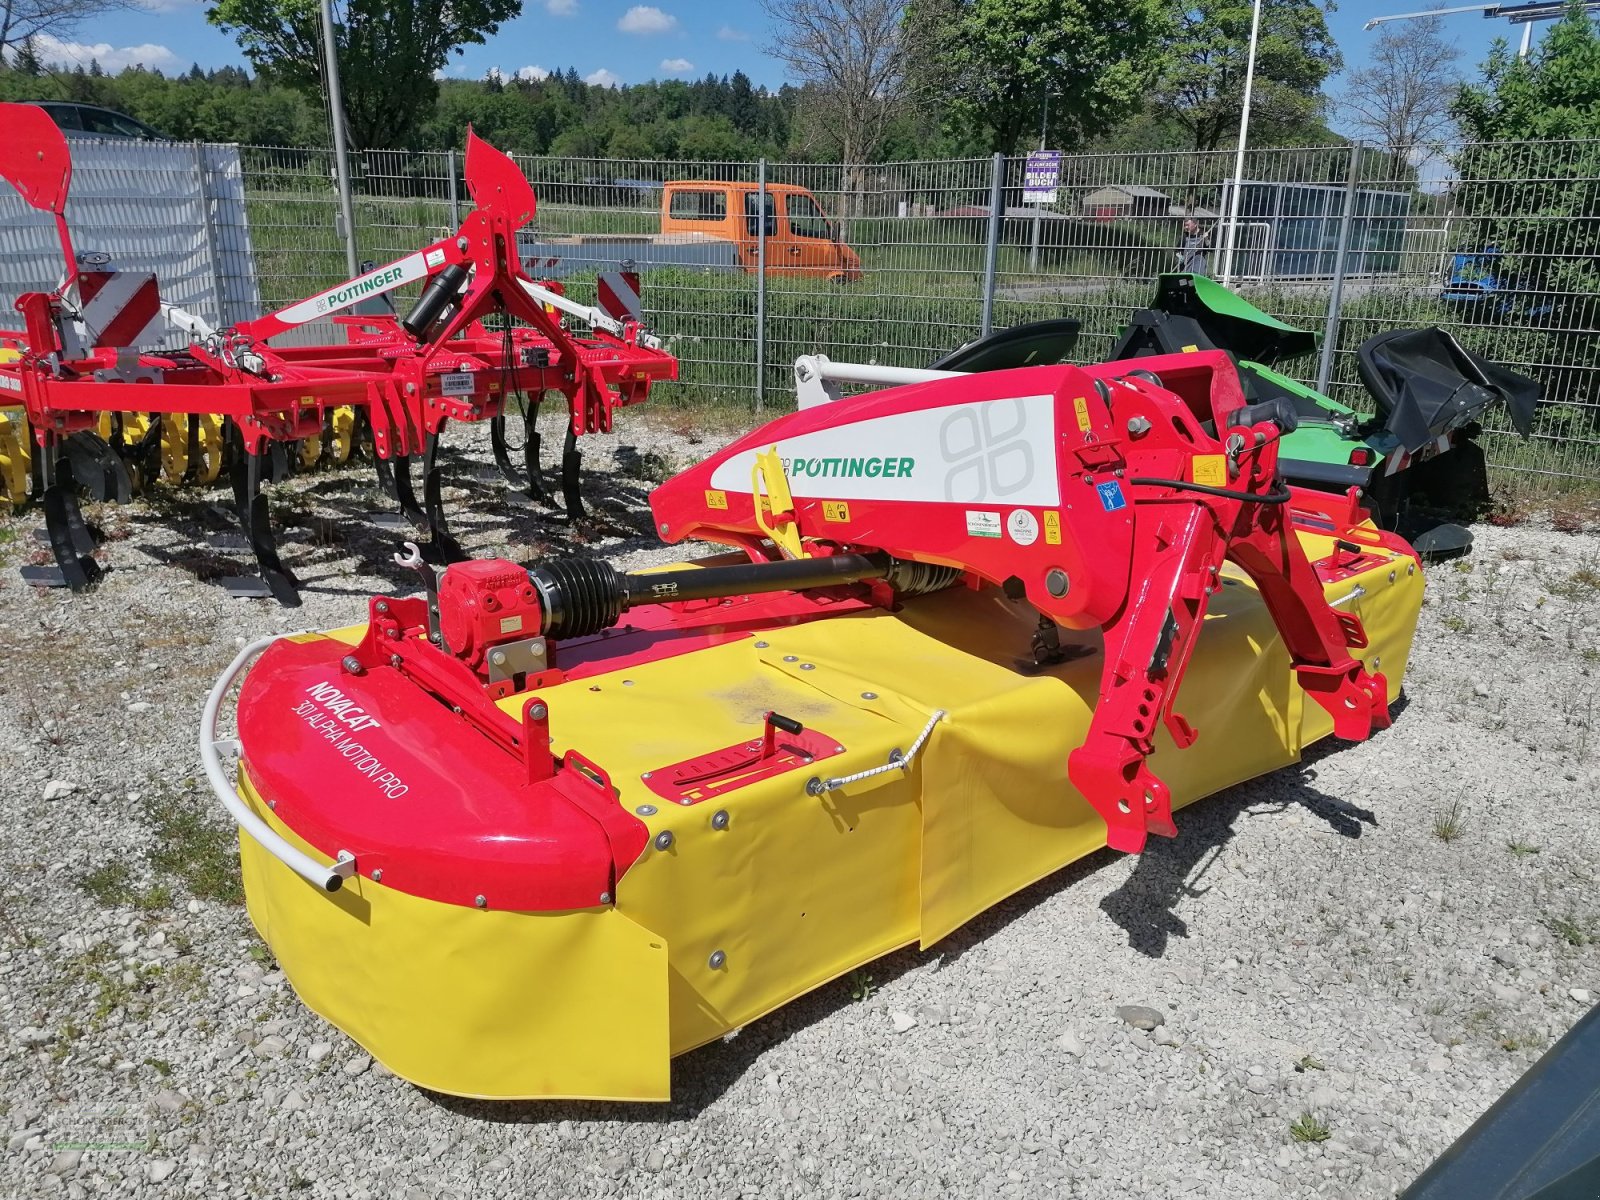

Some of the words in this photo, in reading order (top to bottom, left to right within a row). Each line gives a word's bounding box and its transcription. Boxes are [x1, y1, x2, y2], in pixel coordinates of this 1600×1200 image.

[1026, 171, 1058, 179] BILDER
[327, 267, 404, 307] PÖTTINGER
[792, 457, 915, 478] PÖTTINGER
[291, 699, 319, 718] 301
[305, 681, 381, 732] NOVACAT
[303, 711, 347, 743] ALPHA
[334, 737, 386, 778] MOTION
[372, 771, 409, 799] PRO
